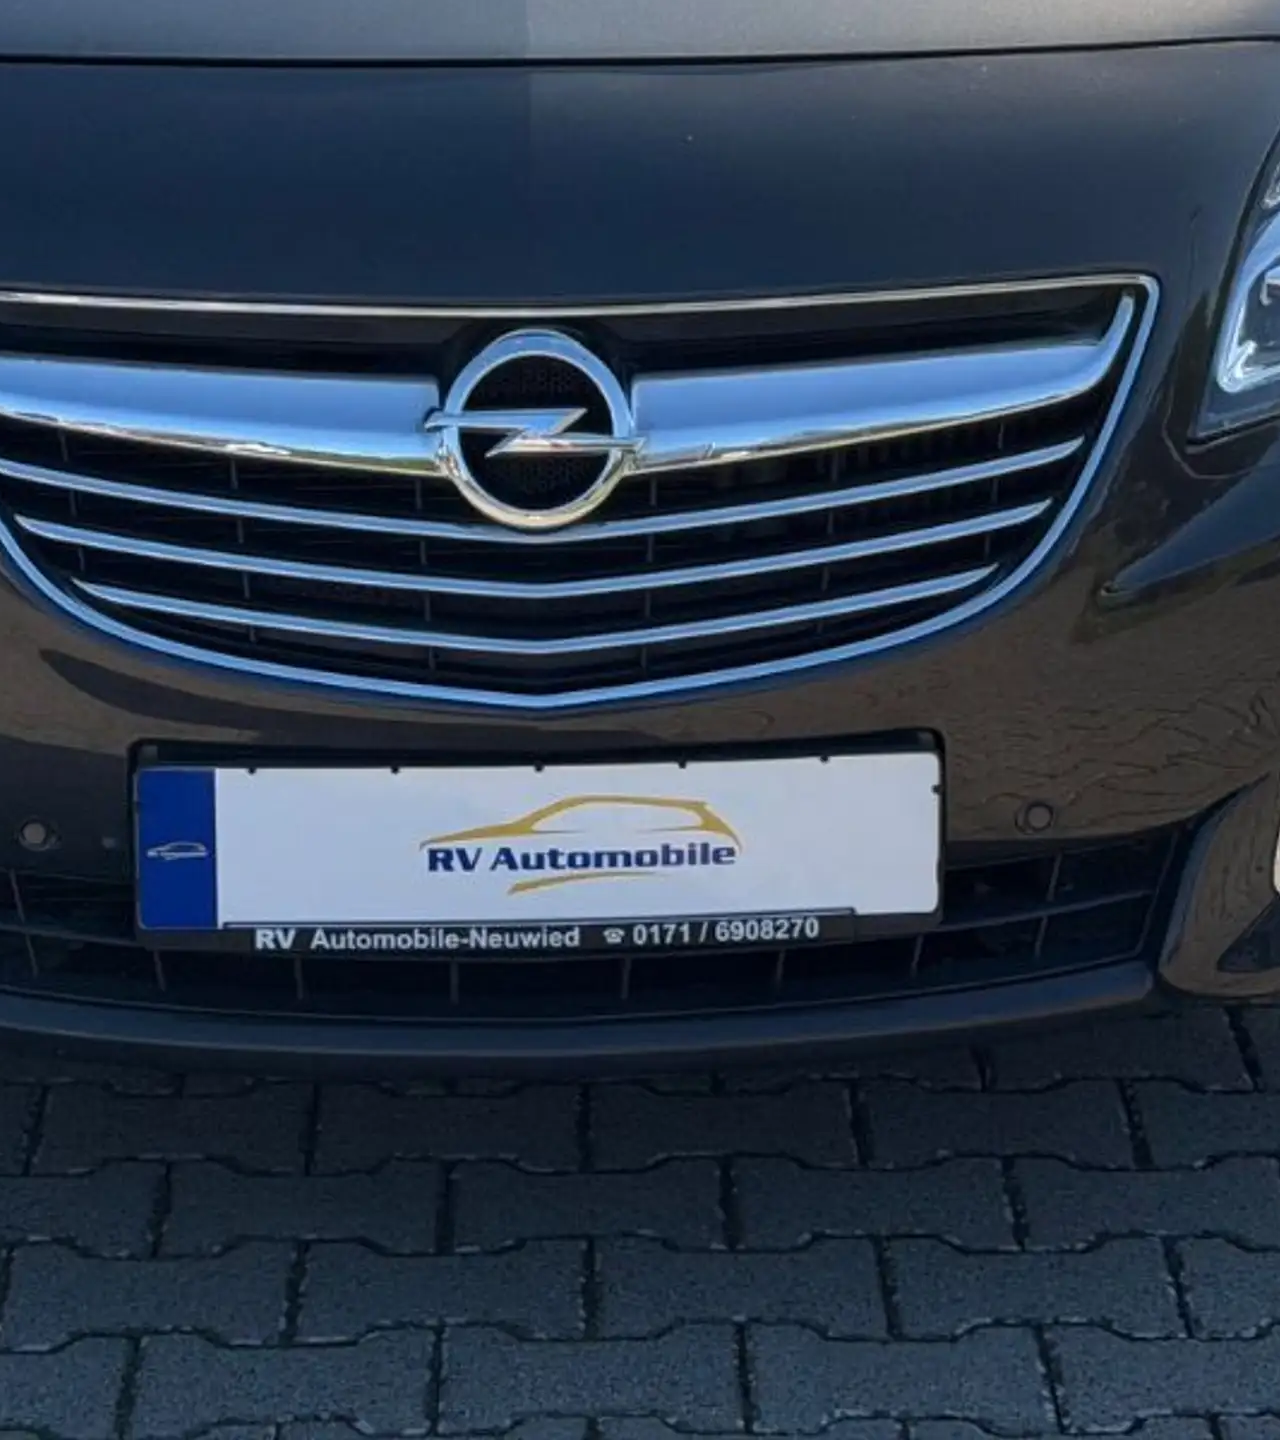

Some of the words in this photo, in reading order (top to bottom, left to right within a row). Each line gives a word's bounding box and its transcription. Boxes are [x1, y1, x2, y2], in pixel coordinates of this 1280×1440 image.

[426, 847, 483, 872] RV
[489, 842, 737, 871] Automobile
[254, 928, 297, 951] RV
[310, 926, 581, 951] Automobile-Neuwied
[631, 922, 692, 947] 0171
[714, 917, 820, 943] 6908270
